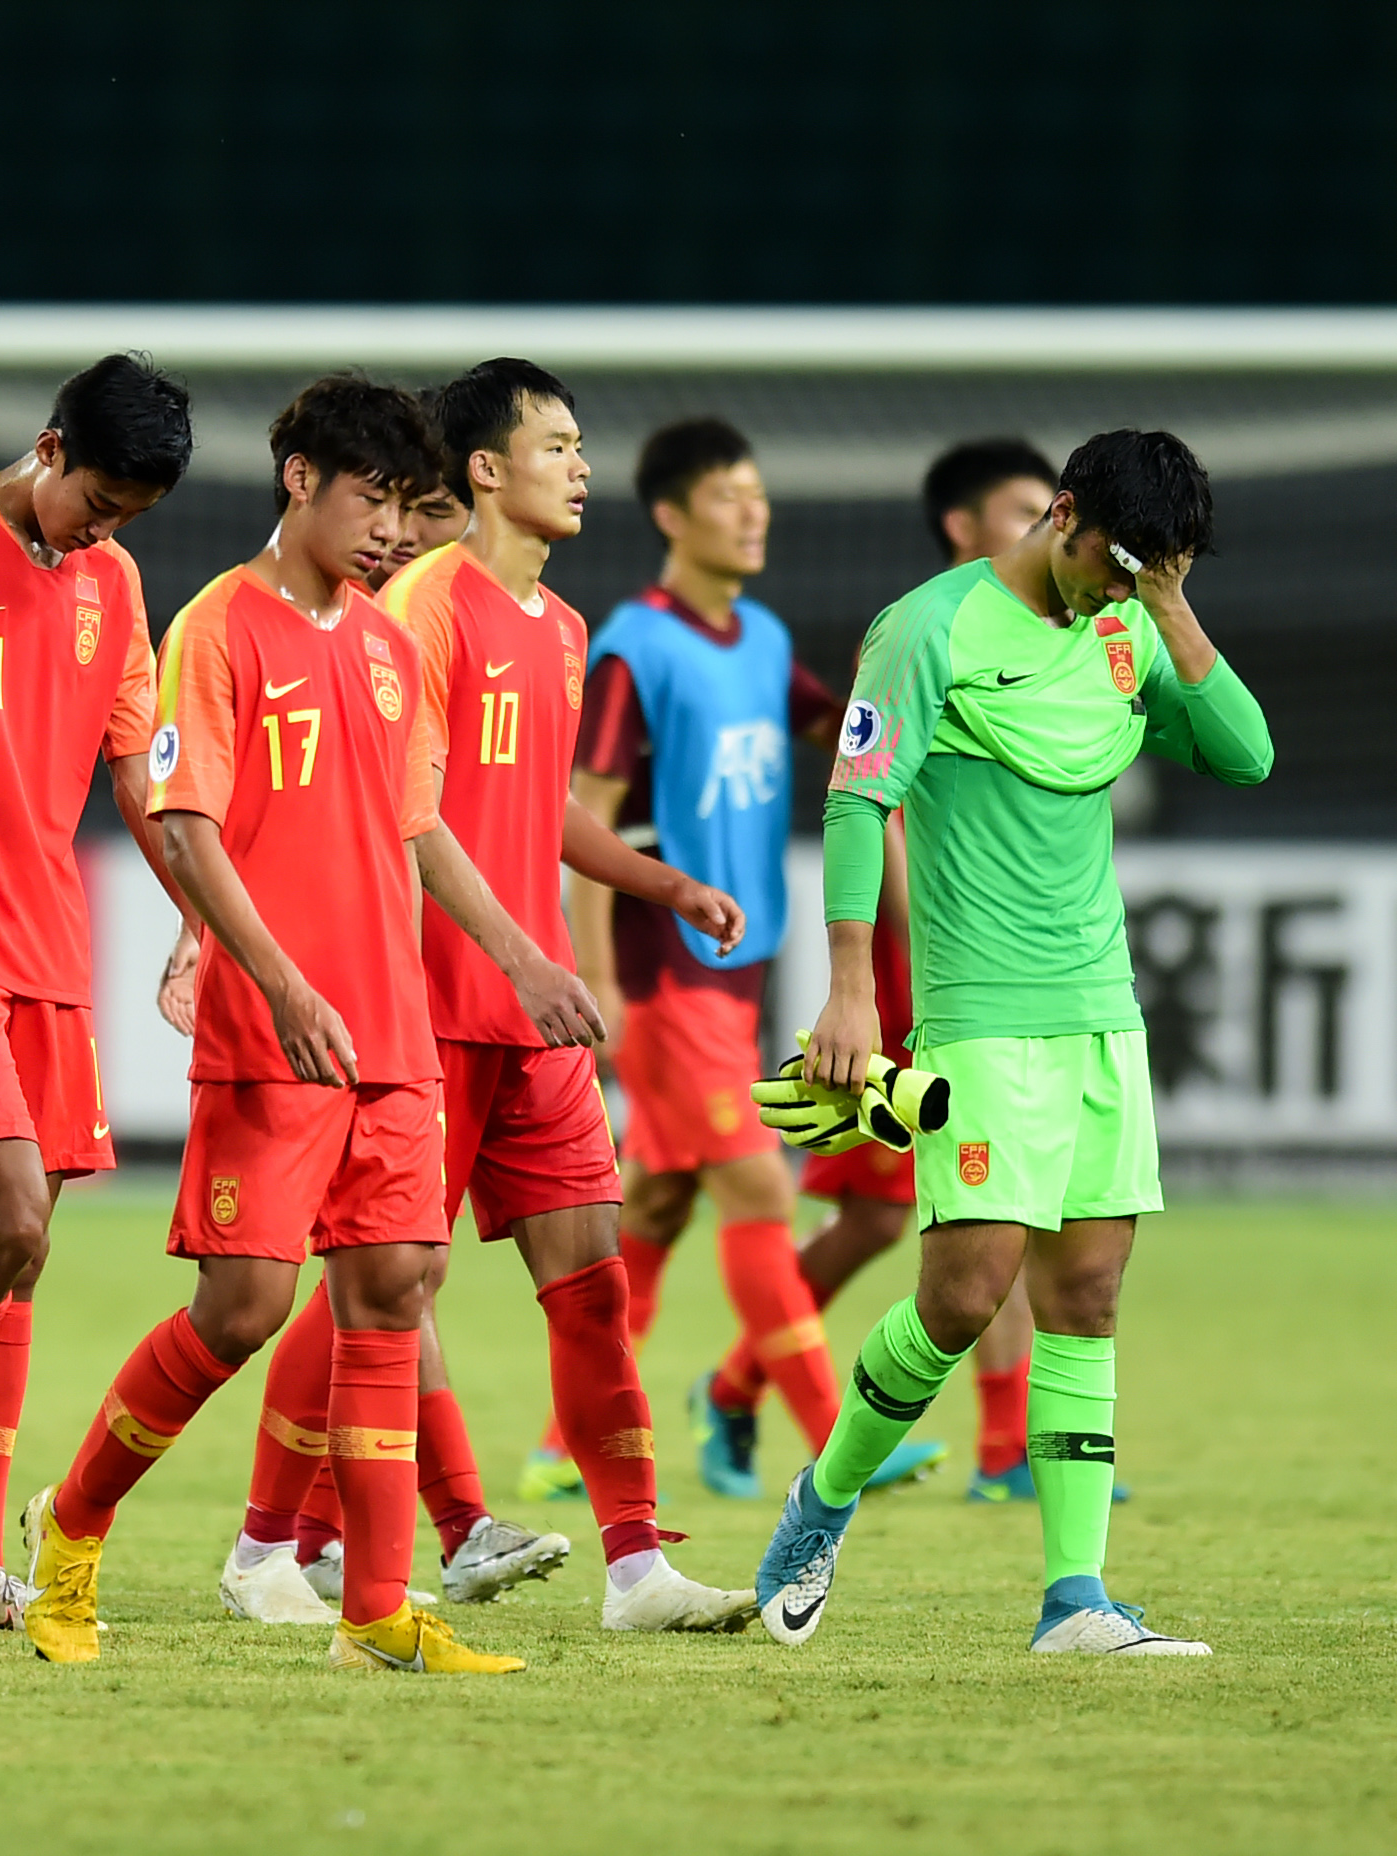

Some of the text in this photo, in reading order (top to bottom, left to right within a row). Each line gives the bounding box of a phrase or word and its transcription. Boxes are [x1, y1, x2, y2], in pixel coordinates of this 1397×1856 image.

[78, 611, 98, 625] CFA
[1107, 644, 1131, 655] CFA
[373, 669, 397, 683] CFA
[479, 691, 519, 765] 10
[262, 708, 321, 791] 17
[960, 1145, 987, 1155] CFA
[214, 1180, 237, 1190] CFA
